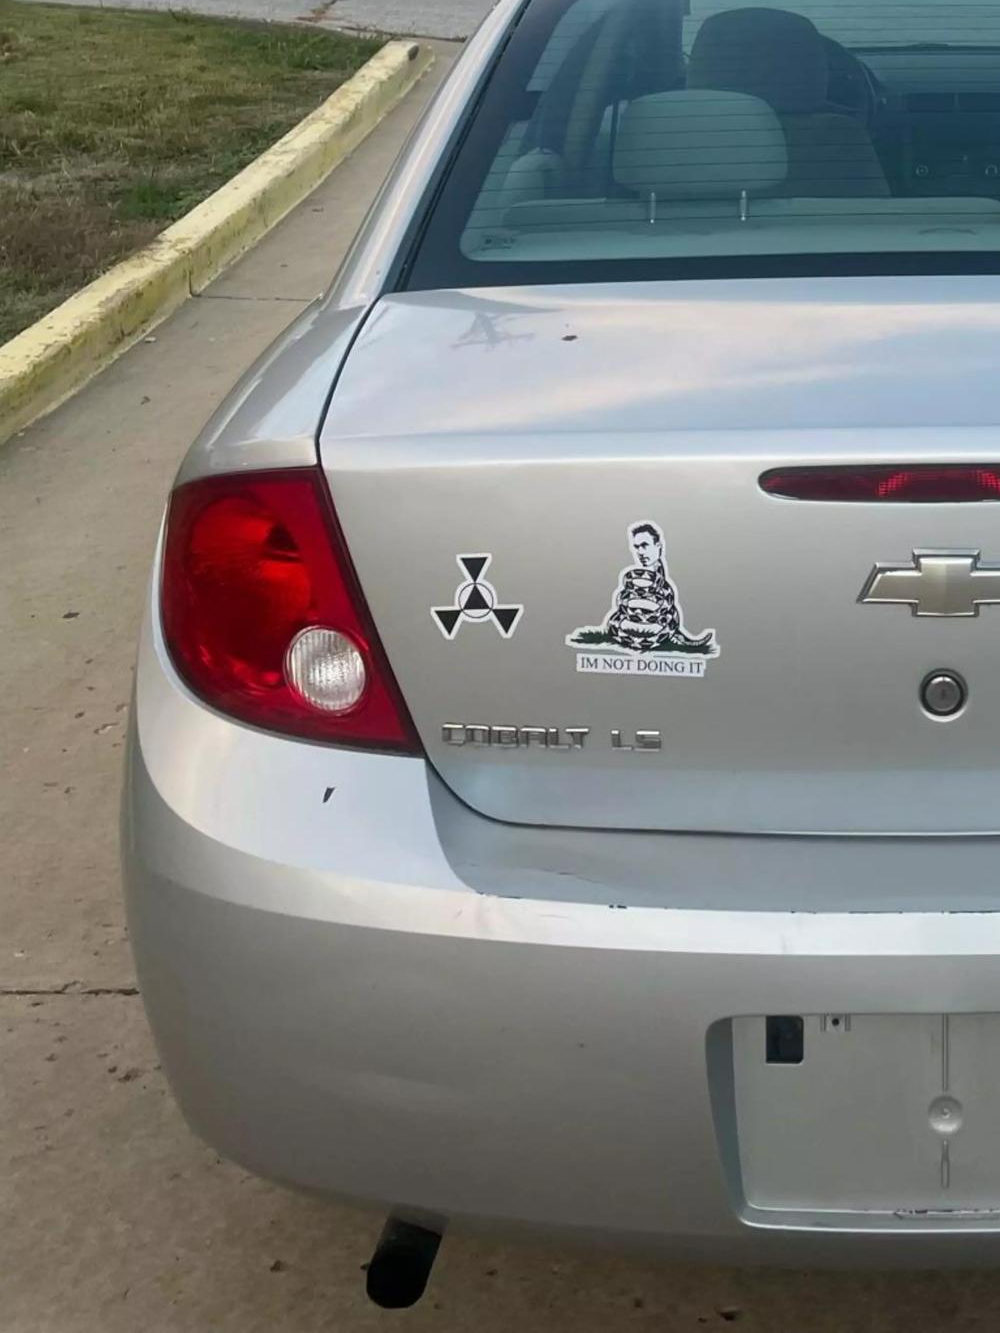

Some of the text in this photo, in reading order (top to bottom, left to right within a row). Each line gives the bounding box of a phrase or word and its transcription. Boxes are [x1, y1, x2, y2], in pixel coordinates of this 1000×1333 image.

[580, 656, 704, 675] IM NOT DOING IT
[442, 723, 662, 753] COBALT LS
